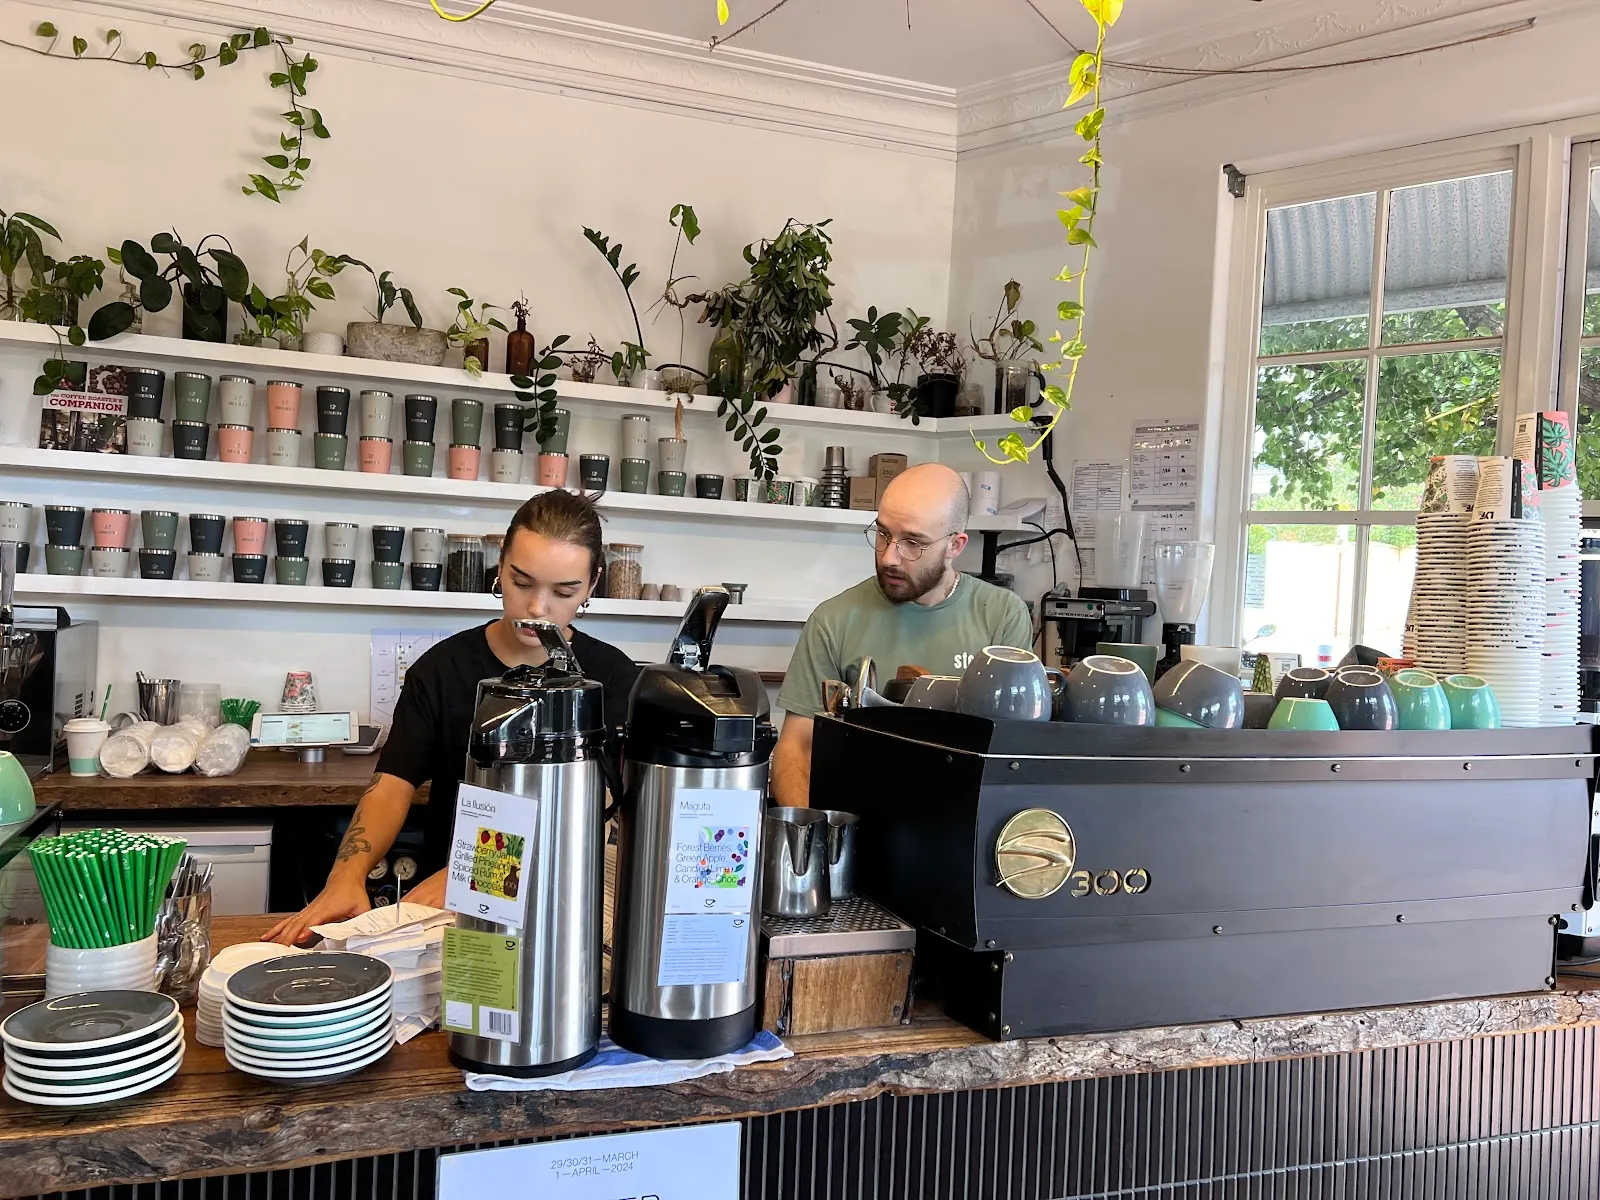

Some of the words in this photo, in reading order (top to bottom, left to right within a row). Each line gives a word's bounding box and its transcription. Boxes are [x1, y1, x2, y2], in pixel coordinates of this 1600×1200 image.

[49, 398, 123, 412] COMPANION
[88, 395, 123, 403] ROASTER'S
[461, 796, 471, 808] La
[472, 799, 496, 813] Ilusión
[679, 801, 711, 813] Maguta
[456, 839, 497, 858] Strawberry
[676, 842, 702, 852] Forest
[455, 850, 478, 864] Grilled
[675, 853, 701, 863] Green
[453, 860, 479, 875] Spiced
[479, 867, 497, 879] Rum
[498, 871, 504, 882] &
[674, 863, 710, 873] Candied
[451, 871, 467, 883] Milk
[673, 874, 680, 884] &
[1070, 867, 1152, 898] 300
